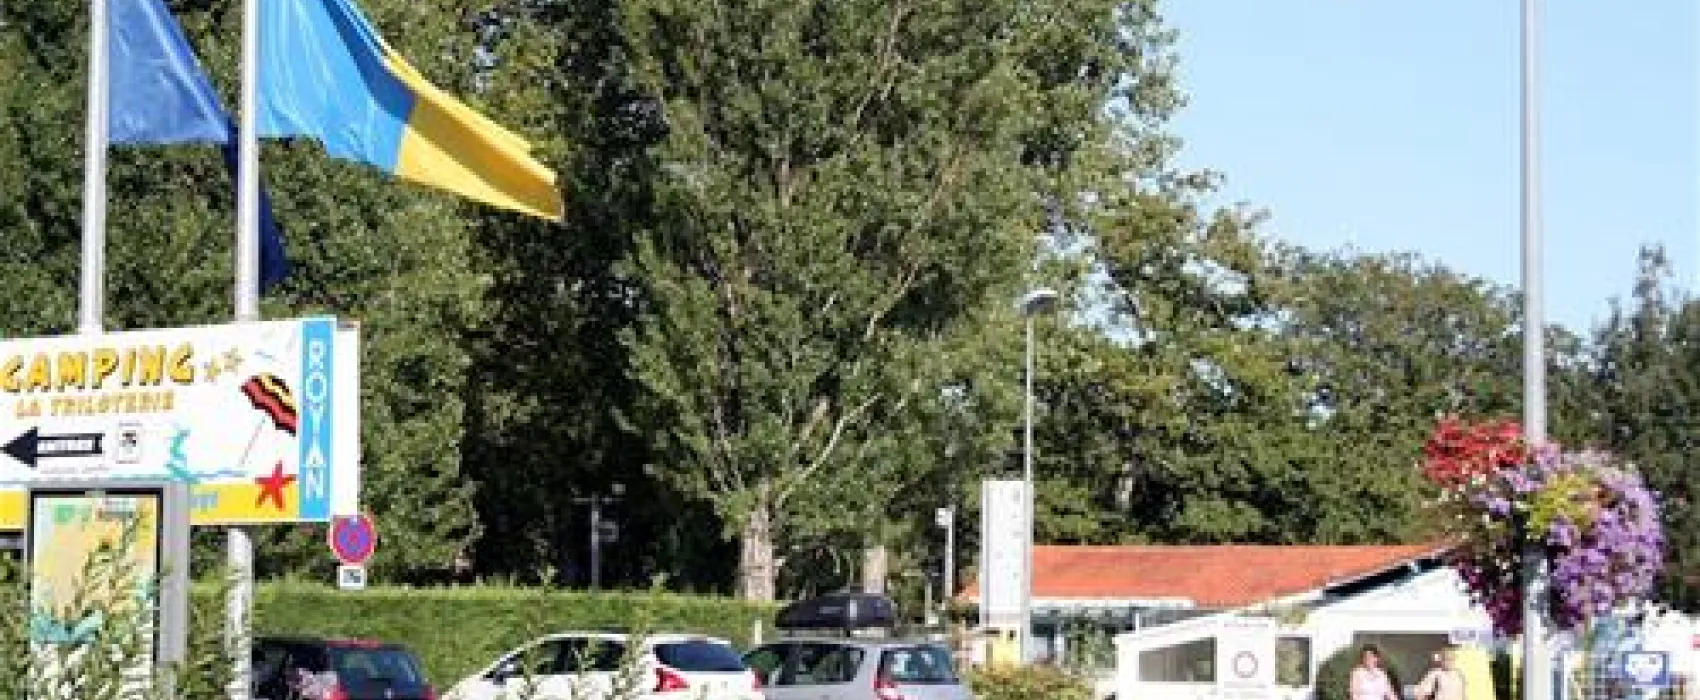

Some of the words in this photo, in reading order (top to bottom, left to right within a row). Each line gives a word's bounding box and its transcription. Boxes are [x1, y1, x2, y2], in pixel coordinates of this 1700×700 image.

[0, 343, 195, 393] CAMPING
[15, 398, 42, 418] LA
[304, 339, 327, 499] ROYAN
